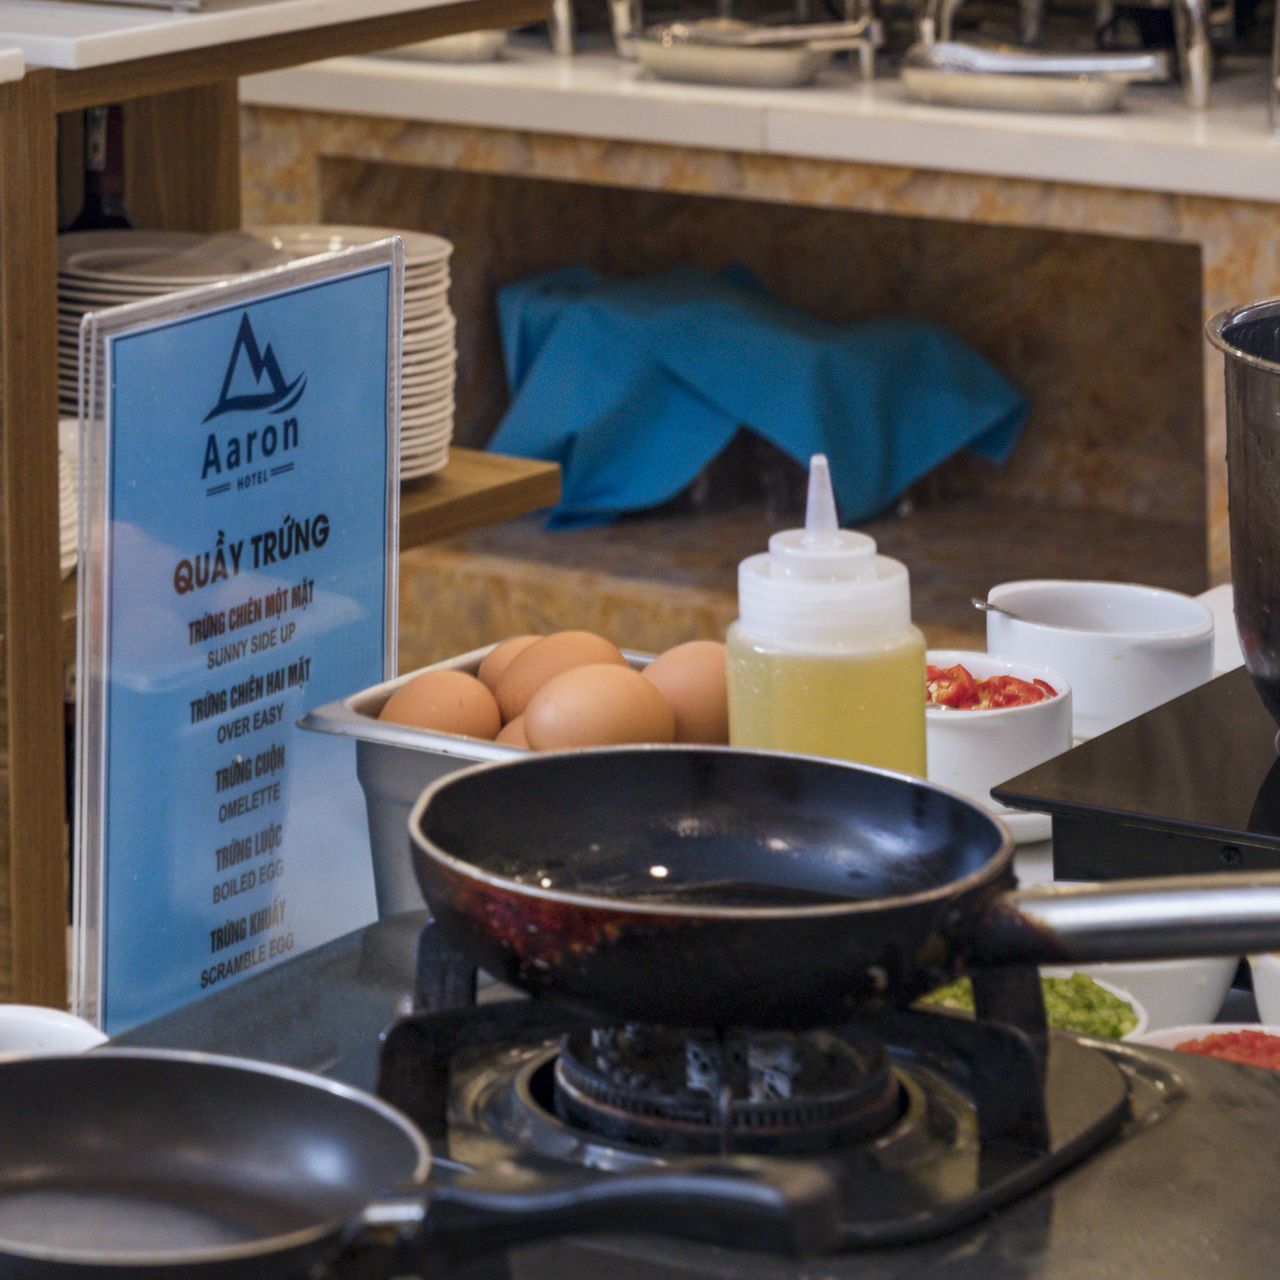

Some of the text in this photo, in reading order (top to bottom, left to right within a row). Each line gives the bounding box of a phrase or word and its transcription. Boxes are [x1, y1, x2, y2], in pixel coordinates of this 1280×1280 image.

[201, 417, 298, 480] Aaron
[237, 470, 268, 491] HOTEL
[251, 514, 329, 569] TRỨNG
[188, 577, 314, 645] TRỨNG CHIÊN MỘT MẶT
[207, 622, 296, 670] SUNNY SIDE UP
[190, 655, 311, 724] TRỨNG CHIÊN HAI MẶT
[217, 703, 284, 744] OVER EASY
[218, 782, 281, 823] OMELETTE
[213, 858, 284, 905] BOILED EGG
[210, 918, 246, 954] TRỨNG
[200, 932, 294, 989] SCRAMBLE EGG
